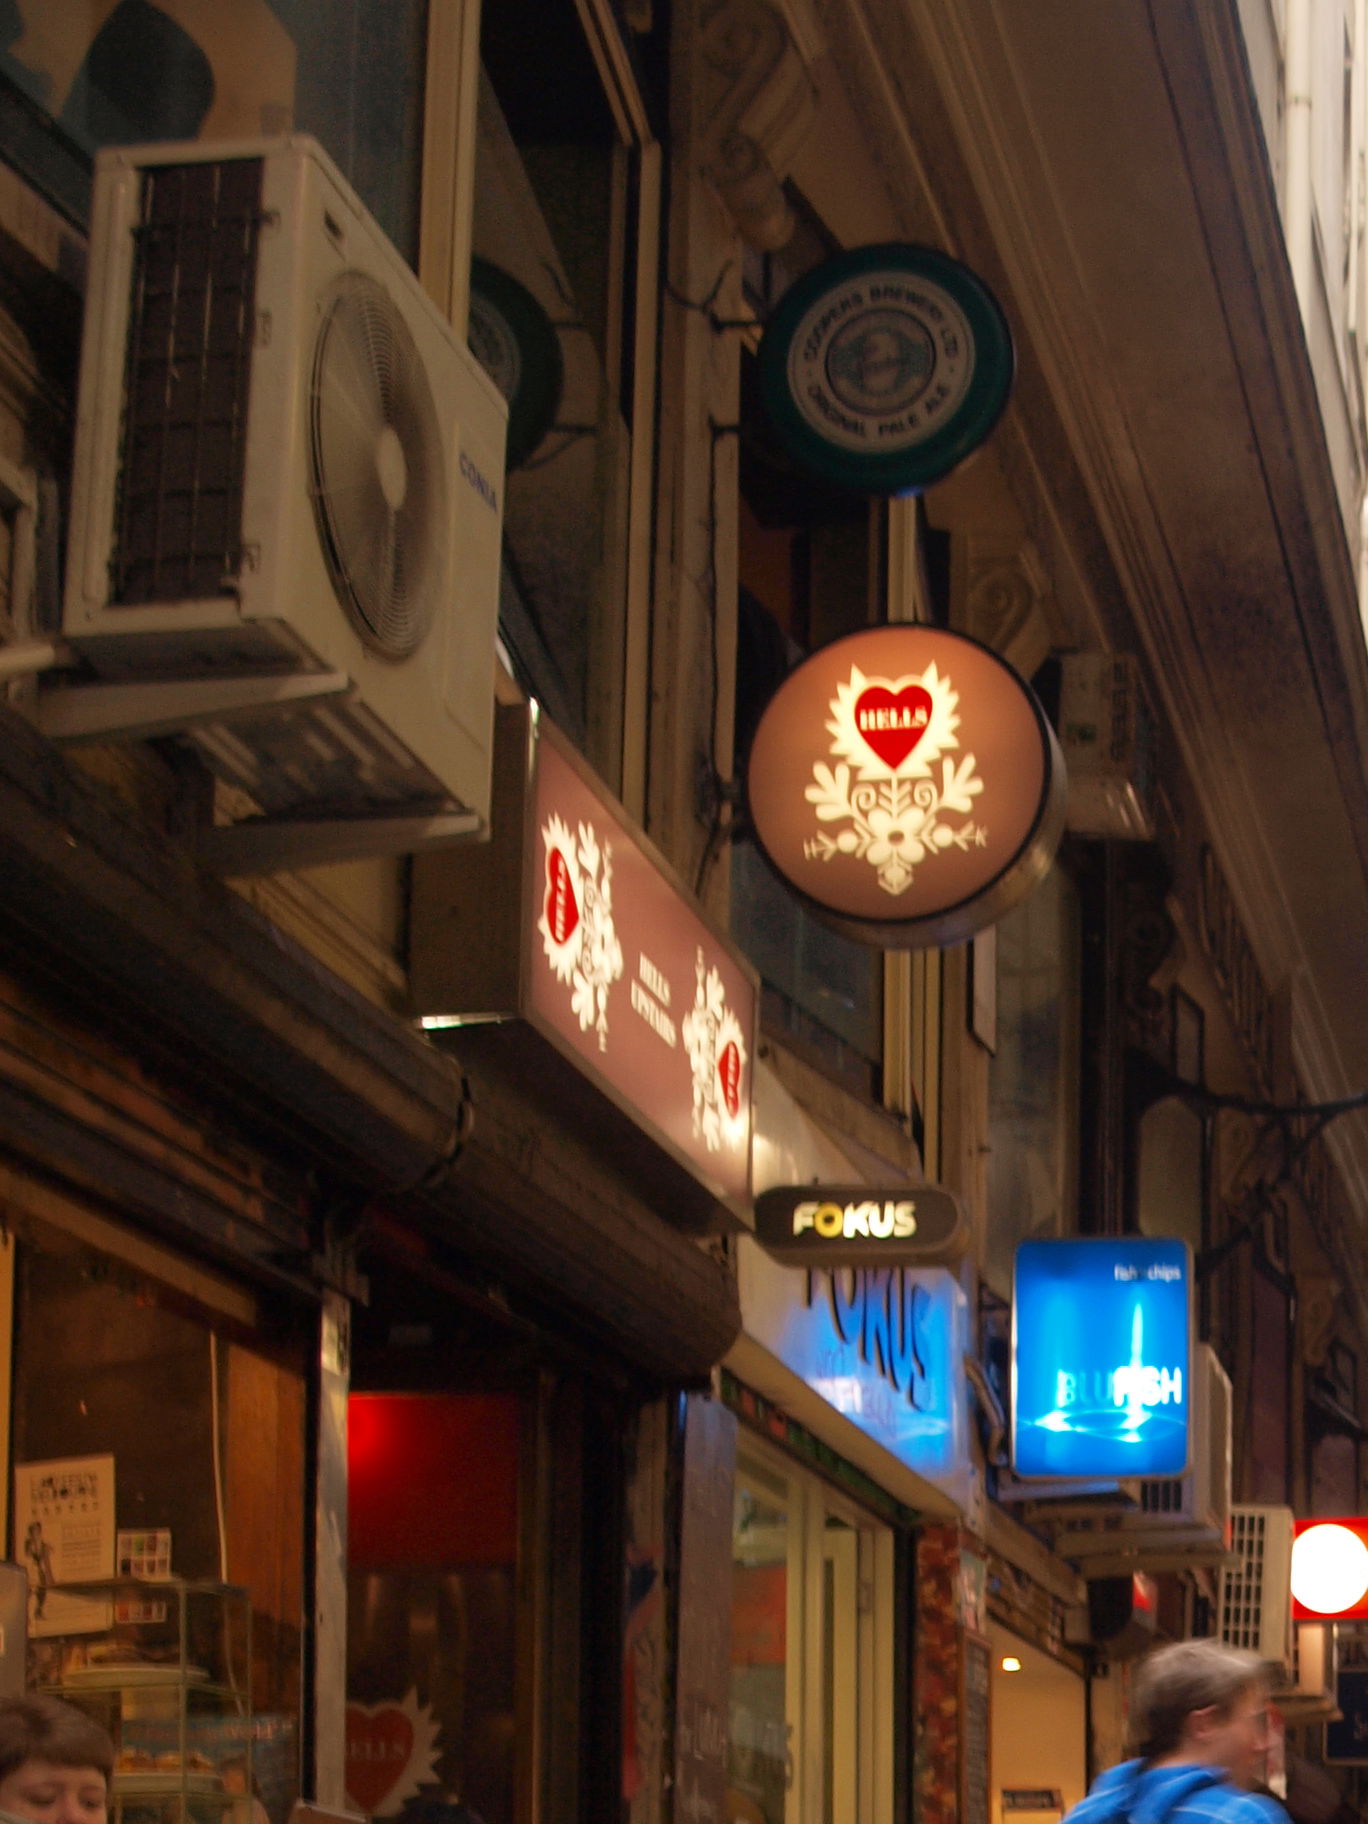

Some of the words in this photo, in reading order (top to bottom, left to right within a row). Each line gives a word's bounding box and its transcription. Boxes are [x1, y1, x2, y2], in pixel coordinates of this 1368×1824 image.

[859, 704, 928, 732] HELLS
[793, 1200, 917, 1239] FOKUS
[347, 1740, 406, 1761] ELLS
